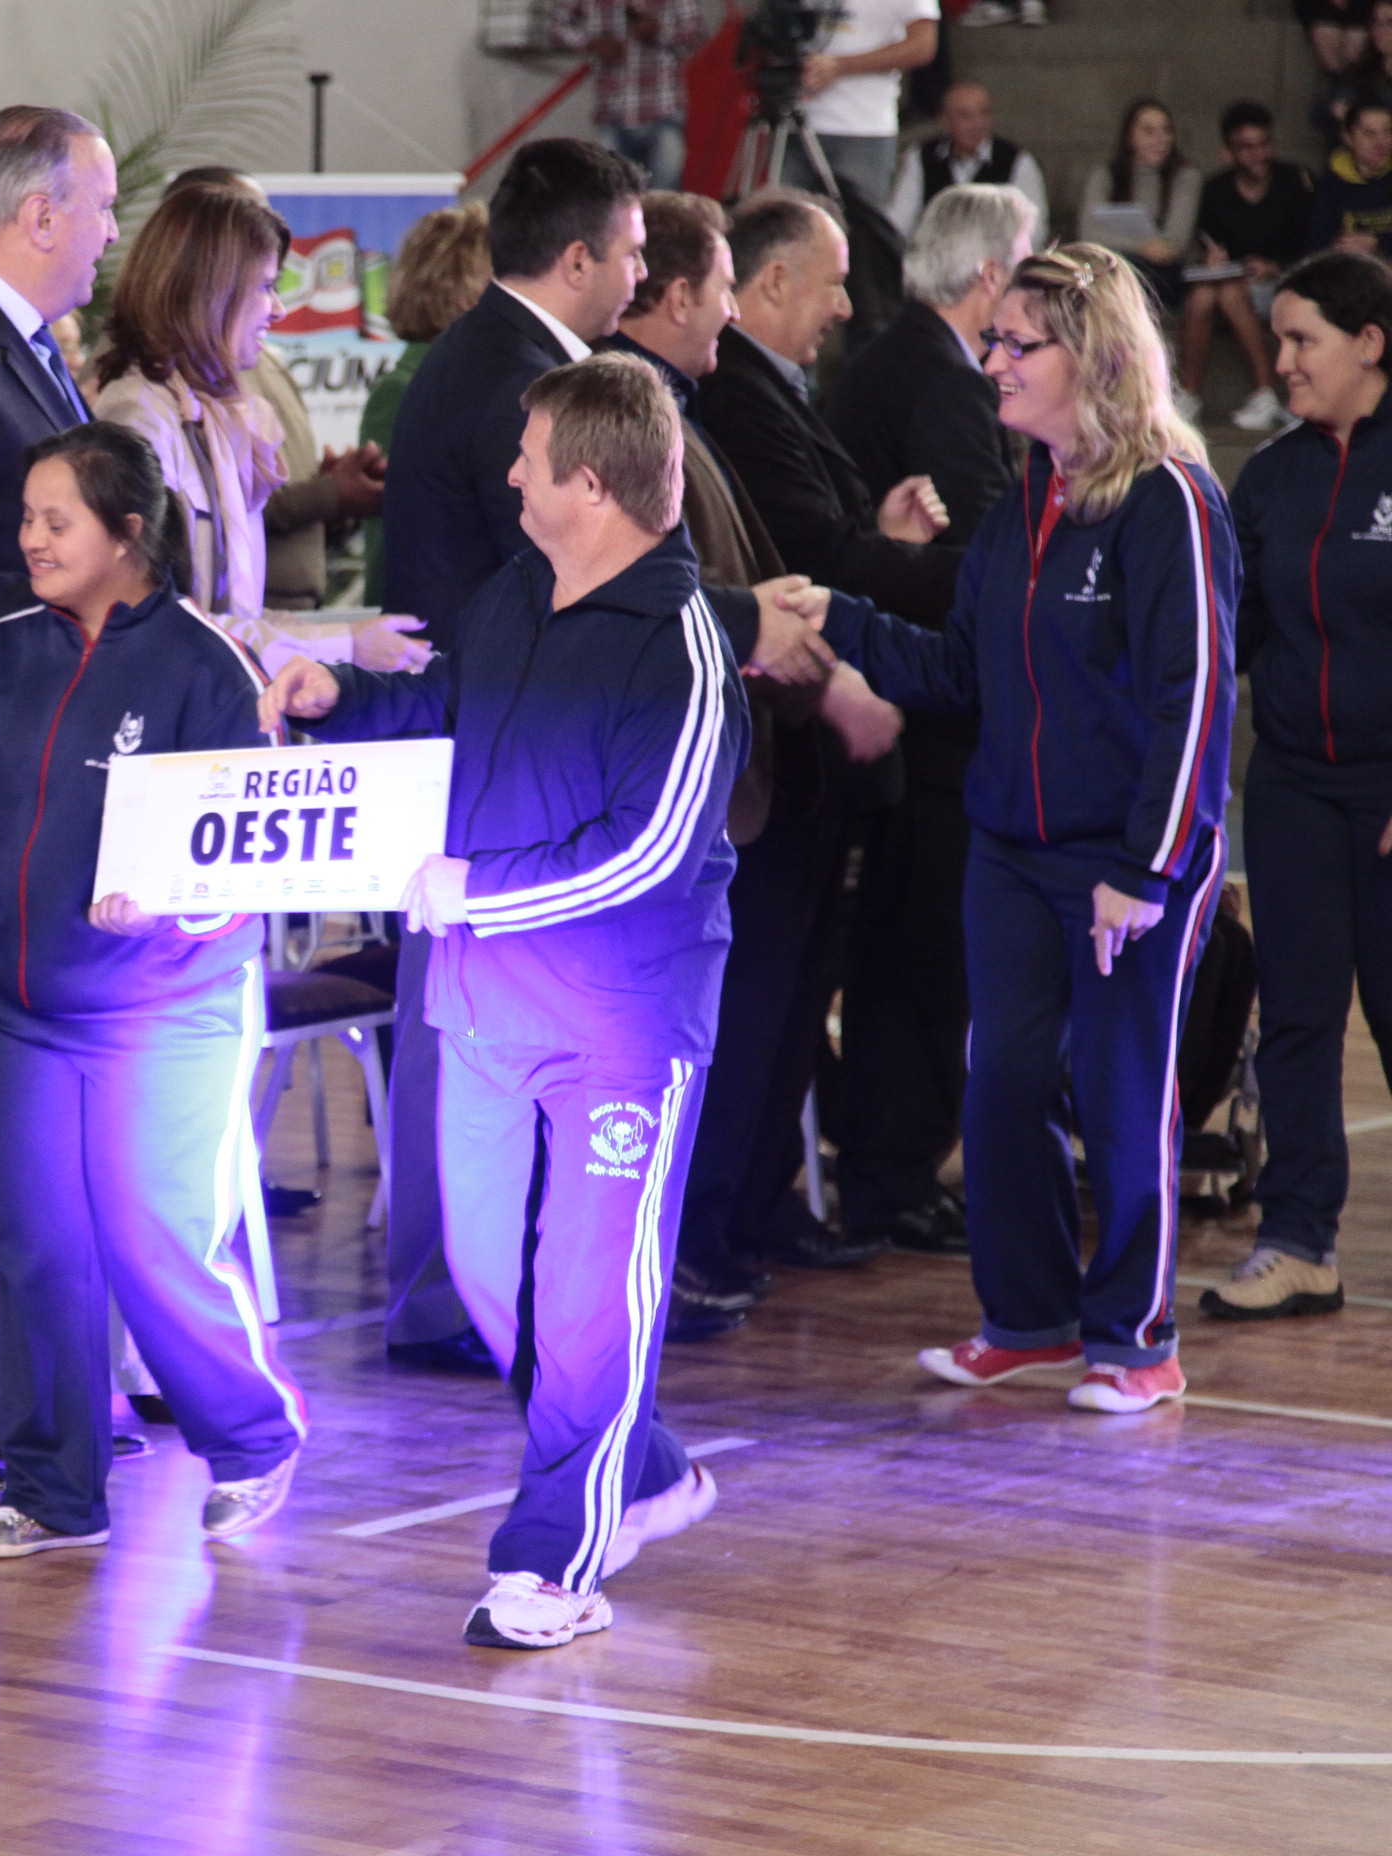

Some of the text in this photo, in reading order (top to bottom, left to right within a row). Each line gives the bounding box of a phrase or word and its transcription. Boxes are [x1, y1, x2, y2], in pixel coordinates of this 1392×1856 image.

[243, 760, 358, 800] REGIÃO
[190, 805, 358, 866] OESTE
[589, 1102, 624, 1122] ESCOLA
